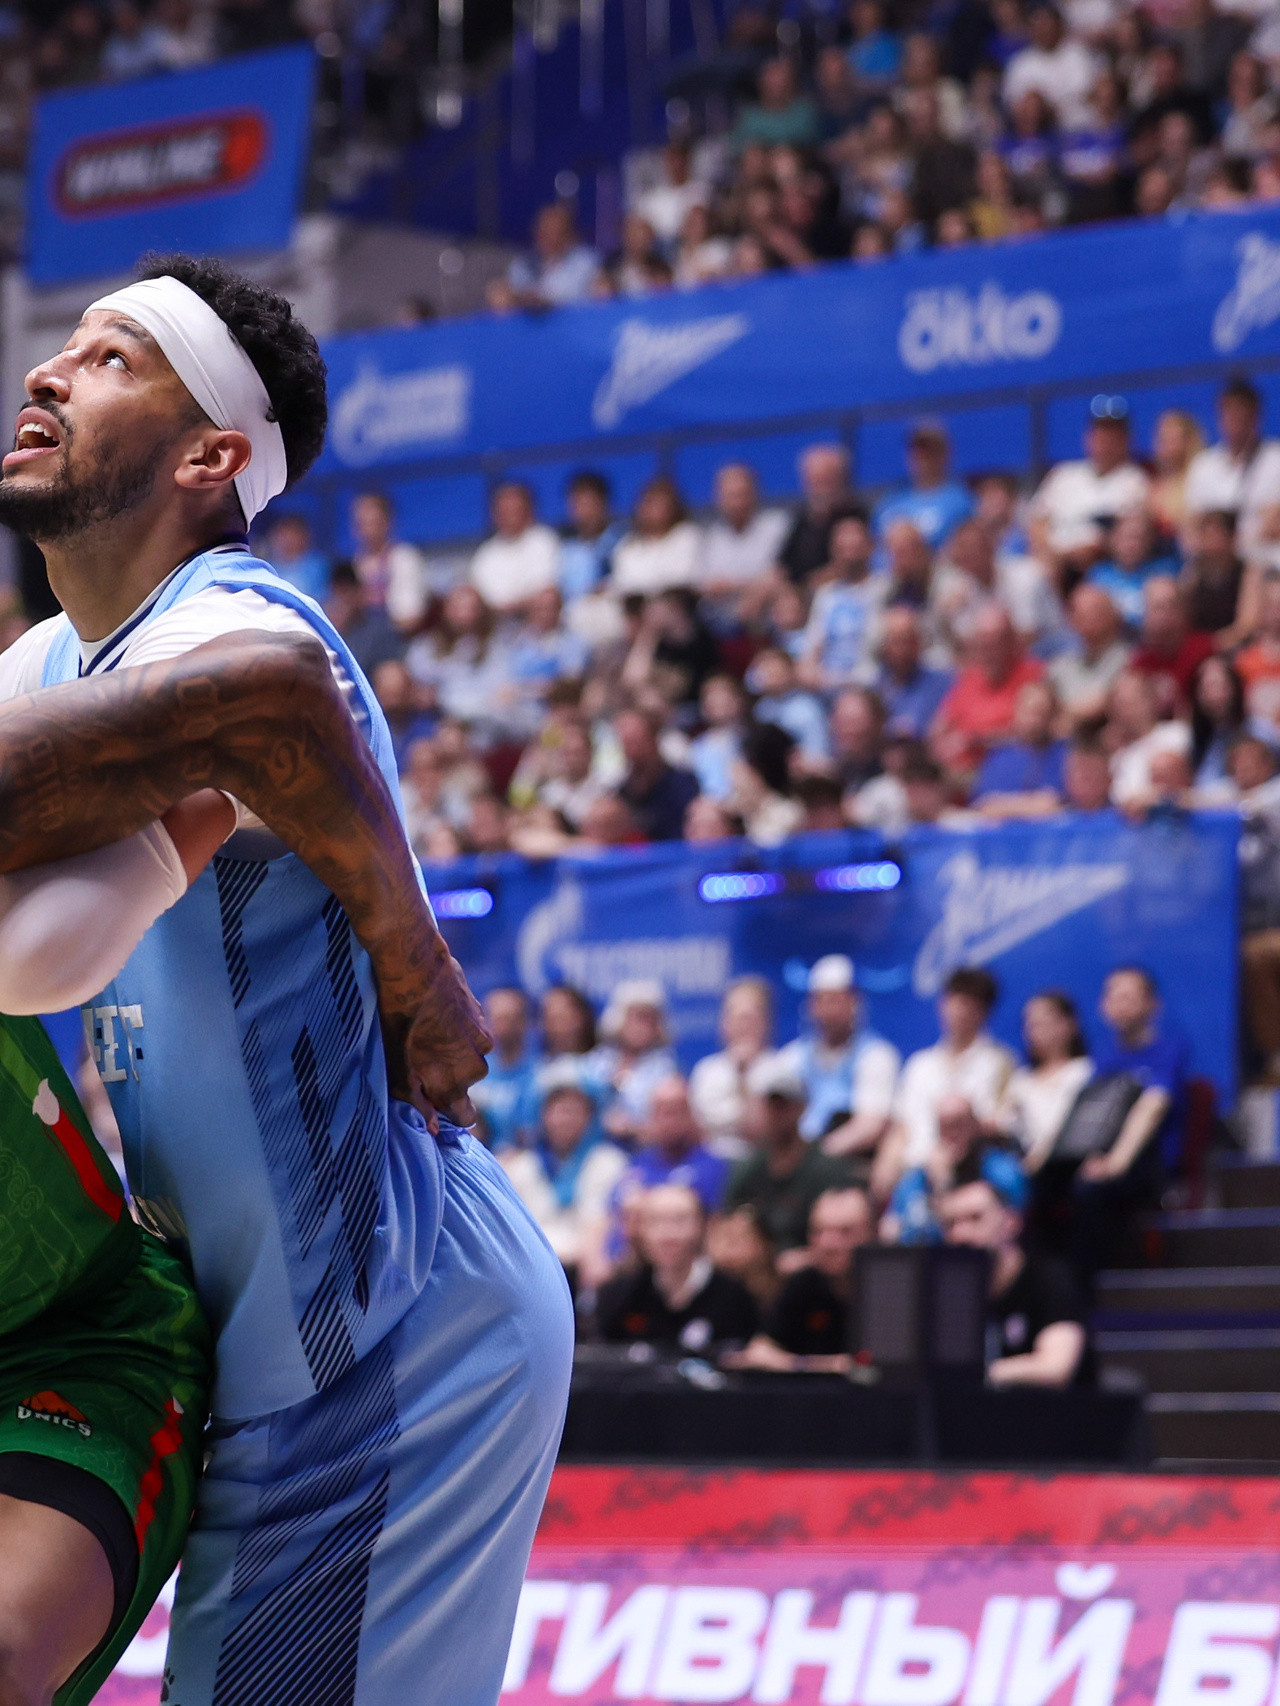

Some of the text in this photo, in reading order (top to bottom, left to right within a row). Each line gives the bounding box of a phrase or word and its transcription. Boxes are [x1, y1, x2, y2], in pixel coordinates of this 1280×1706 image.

[17, 1405, 91, 1437] UNICS
[500, 1561, 1280, 1706] ТИВНЫЙ Б
